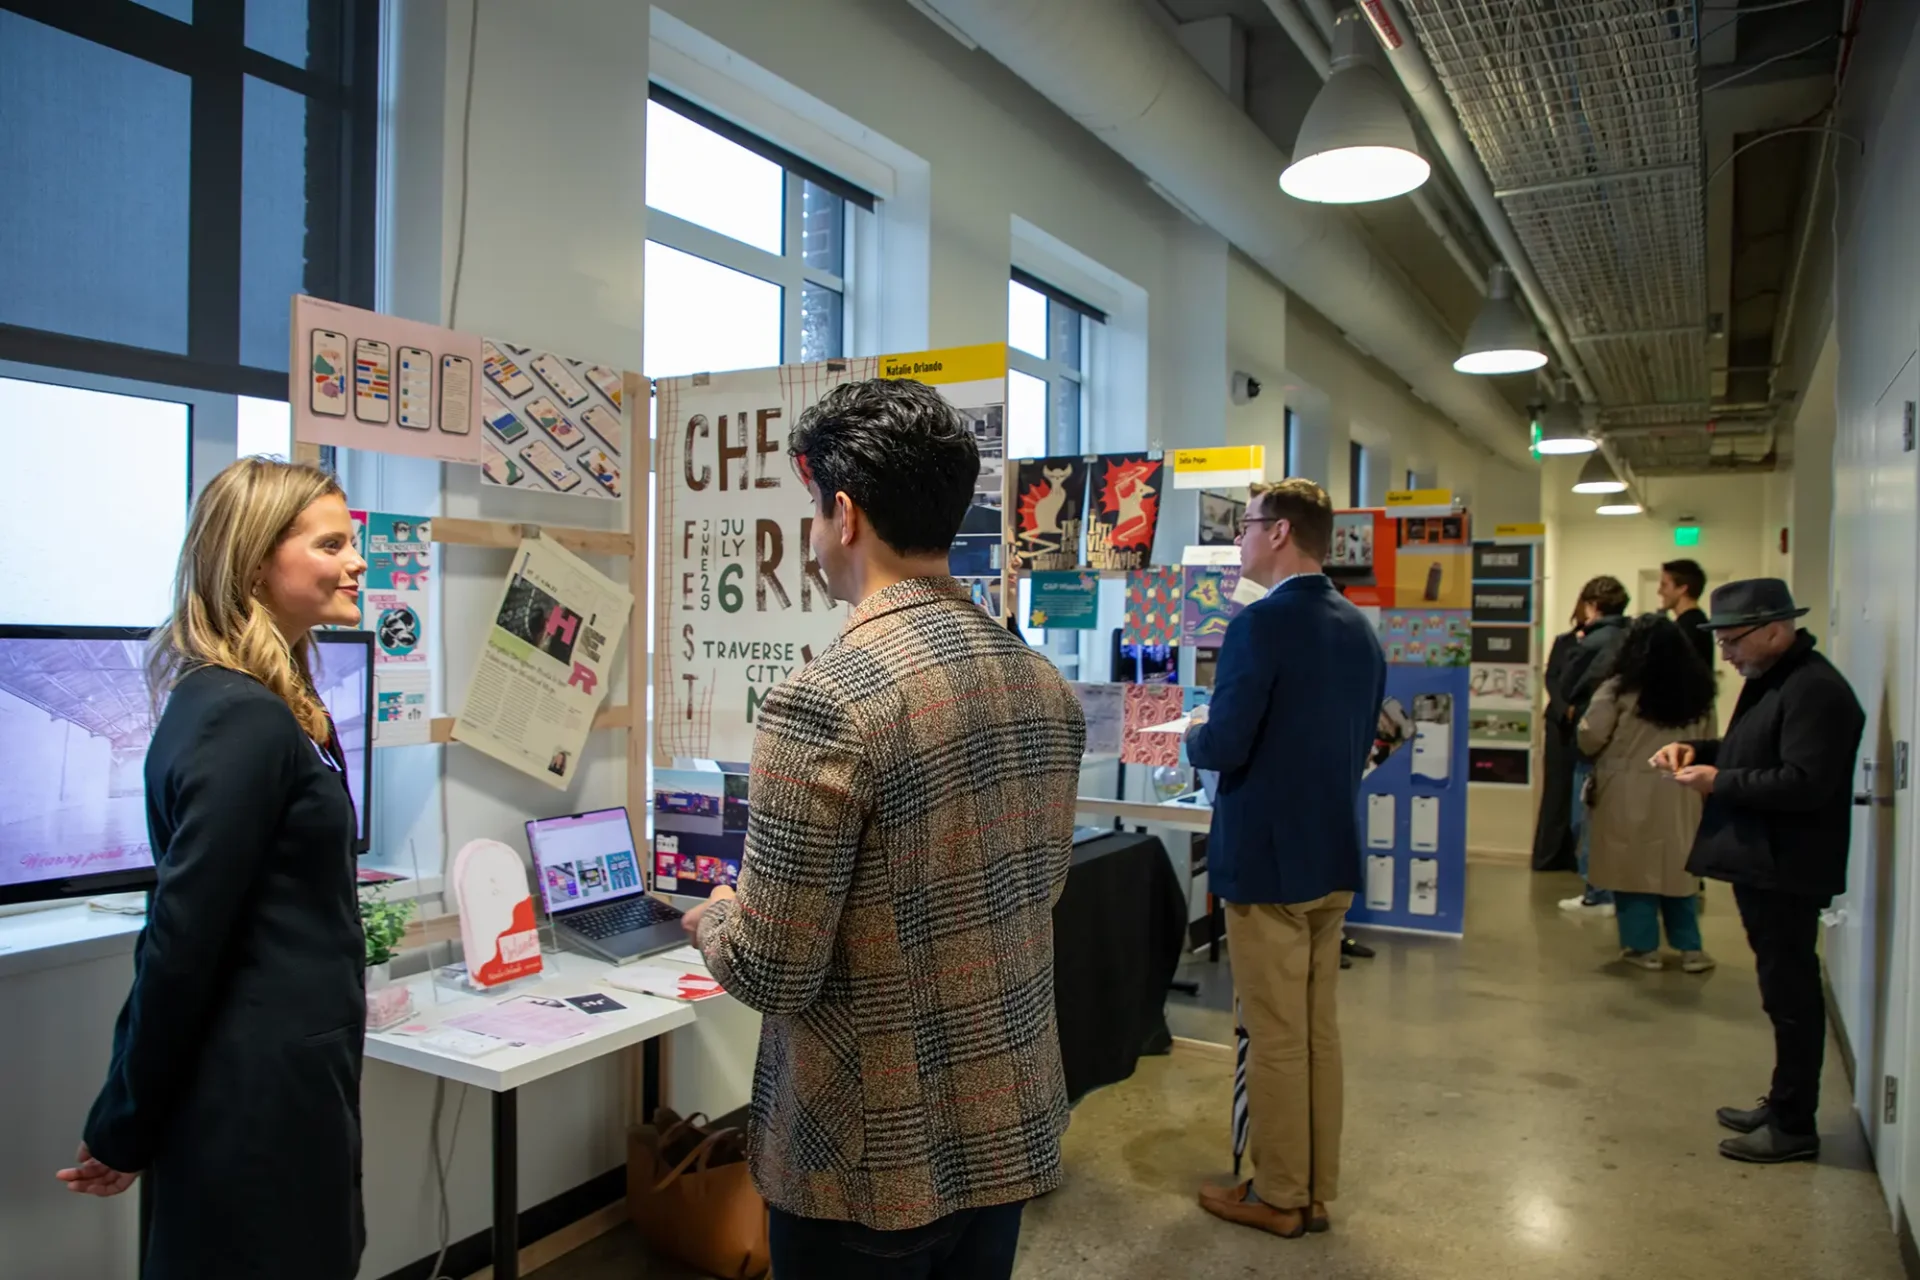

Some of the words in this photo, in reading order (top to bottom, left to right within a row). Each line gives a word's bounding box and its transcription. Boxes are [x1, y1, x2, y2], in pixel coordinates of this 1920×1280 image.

[886, 363, 912, 376] Natalie
[913, 360, 943, 373] Orlando
[717, 562, 744, 614] 6
[703, 641, 795, 661] TRAVERSE
[746, 664, 794, 684] CITY
